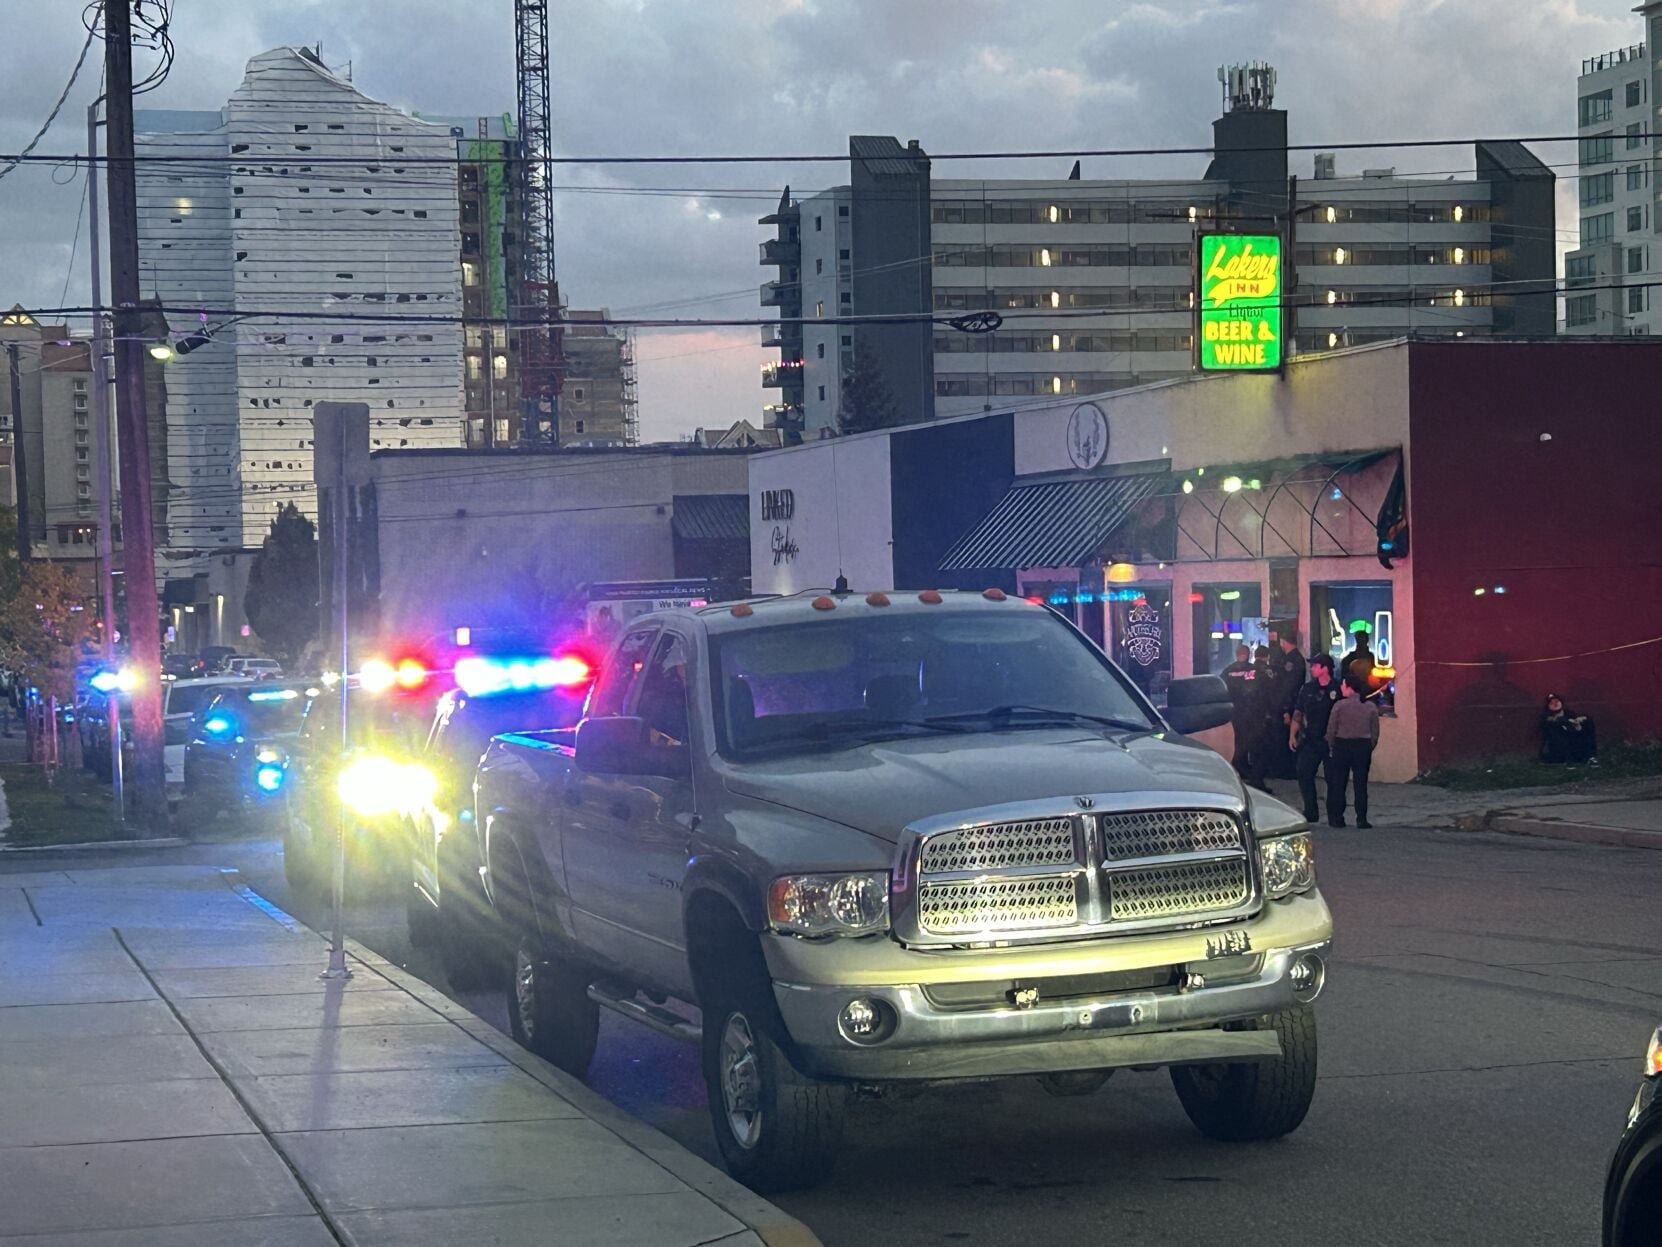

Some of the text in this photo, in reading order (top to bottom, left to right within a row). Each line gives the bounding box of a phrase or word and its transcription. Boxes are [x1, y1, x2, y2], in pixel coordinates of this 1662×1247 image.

[1229, 283, 1260, 294] INN
[1205, 321, 1276, 341] BEER &
[1215, 343, 1266, 364] WINE
